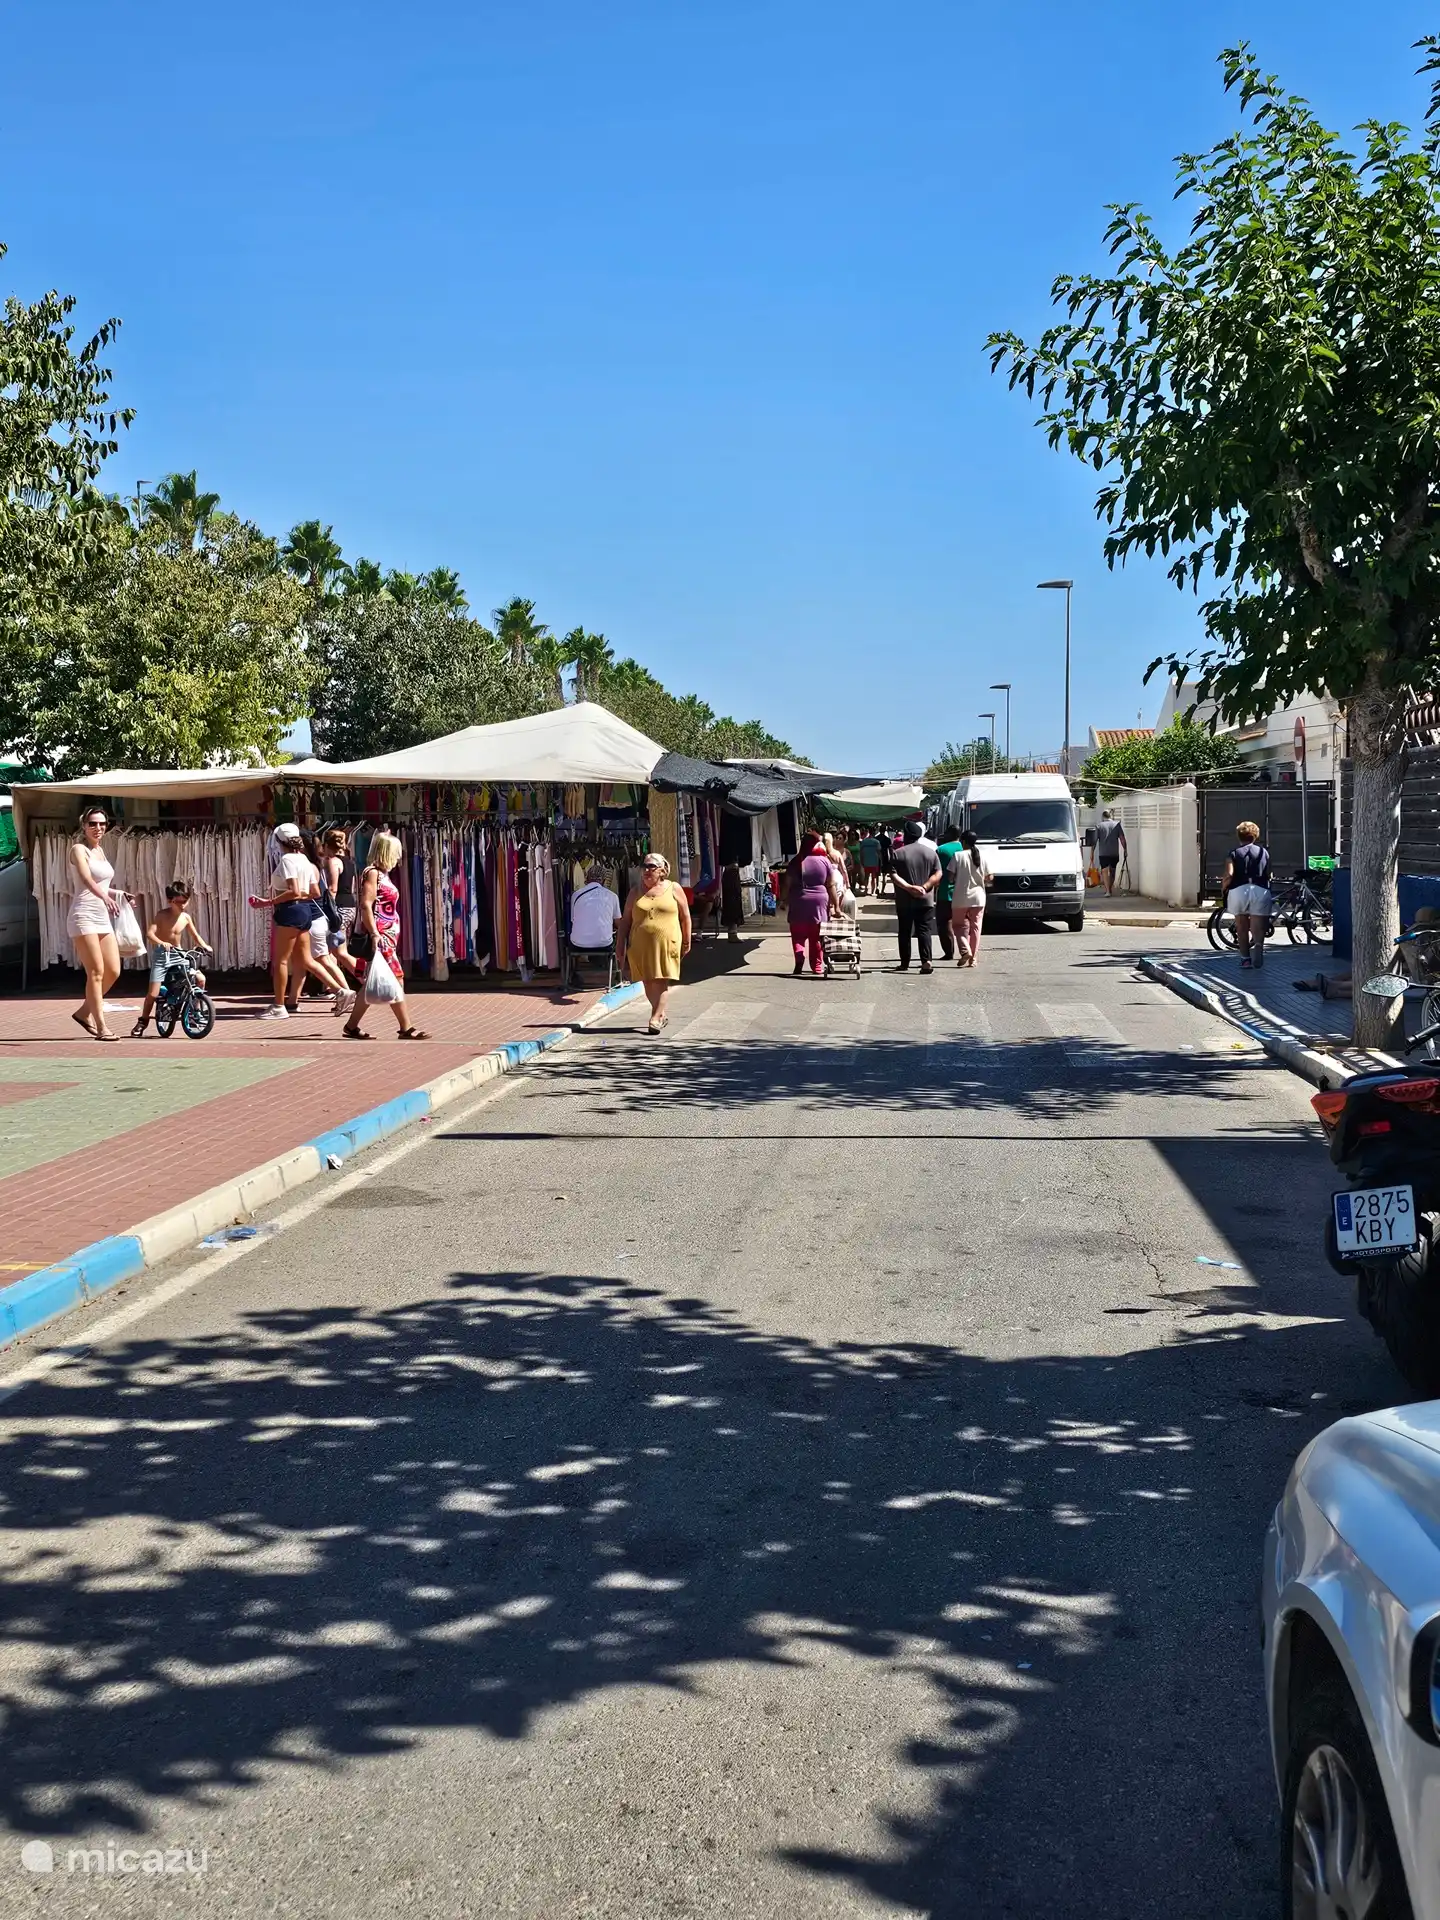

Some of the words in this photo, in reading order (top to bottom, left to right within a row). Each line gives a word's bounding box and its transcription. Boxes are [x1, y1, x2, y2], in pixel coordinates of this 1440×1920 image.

[1354, 1190, 1409, 1218] 2875
[1342, 1217, 1348, 1226] E
[1356, 1217, 1395, 1244] KBY
